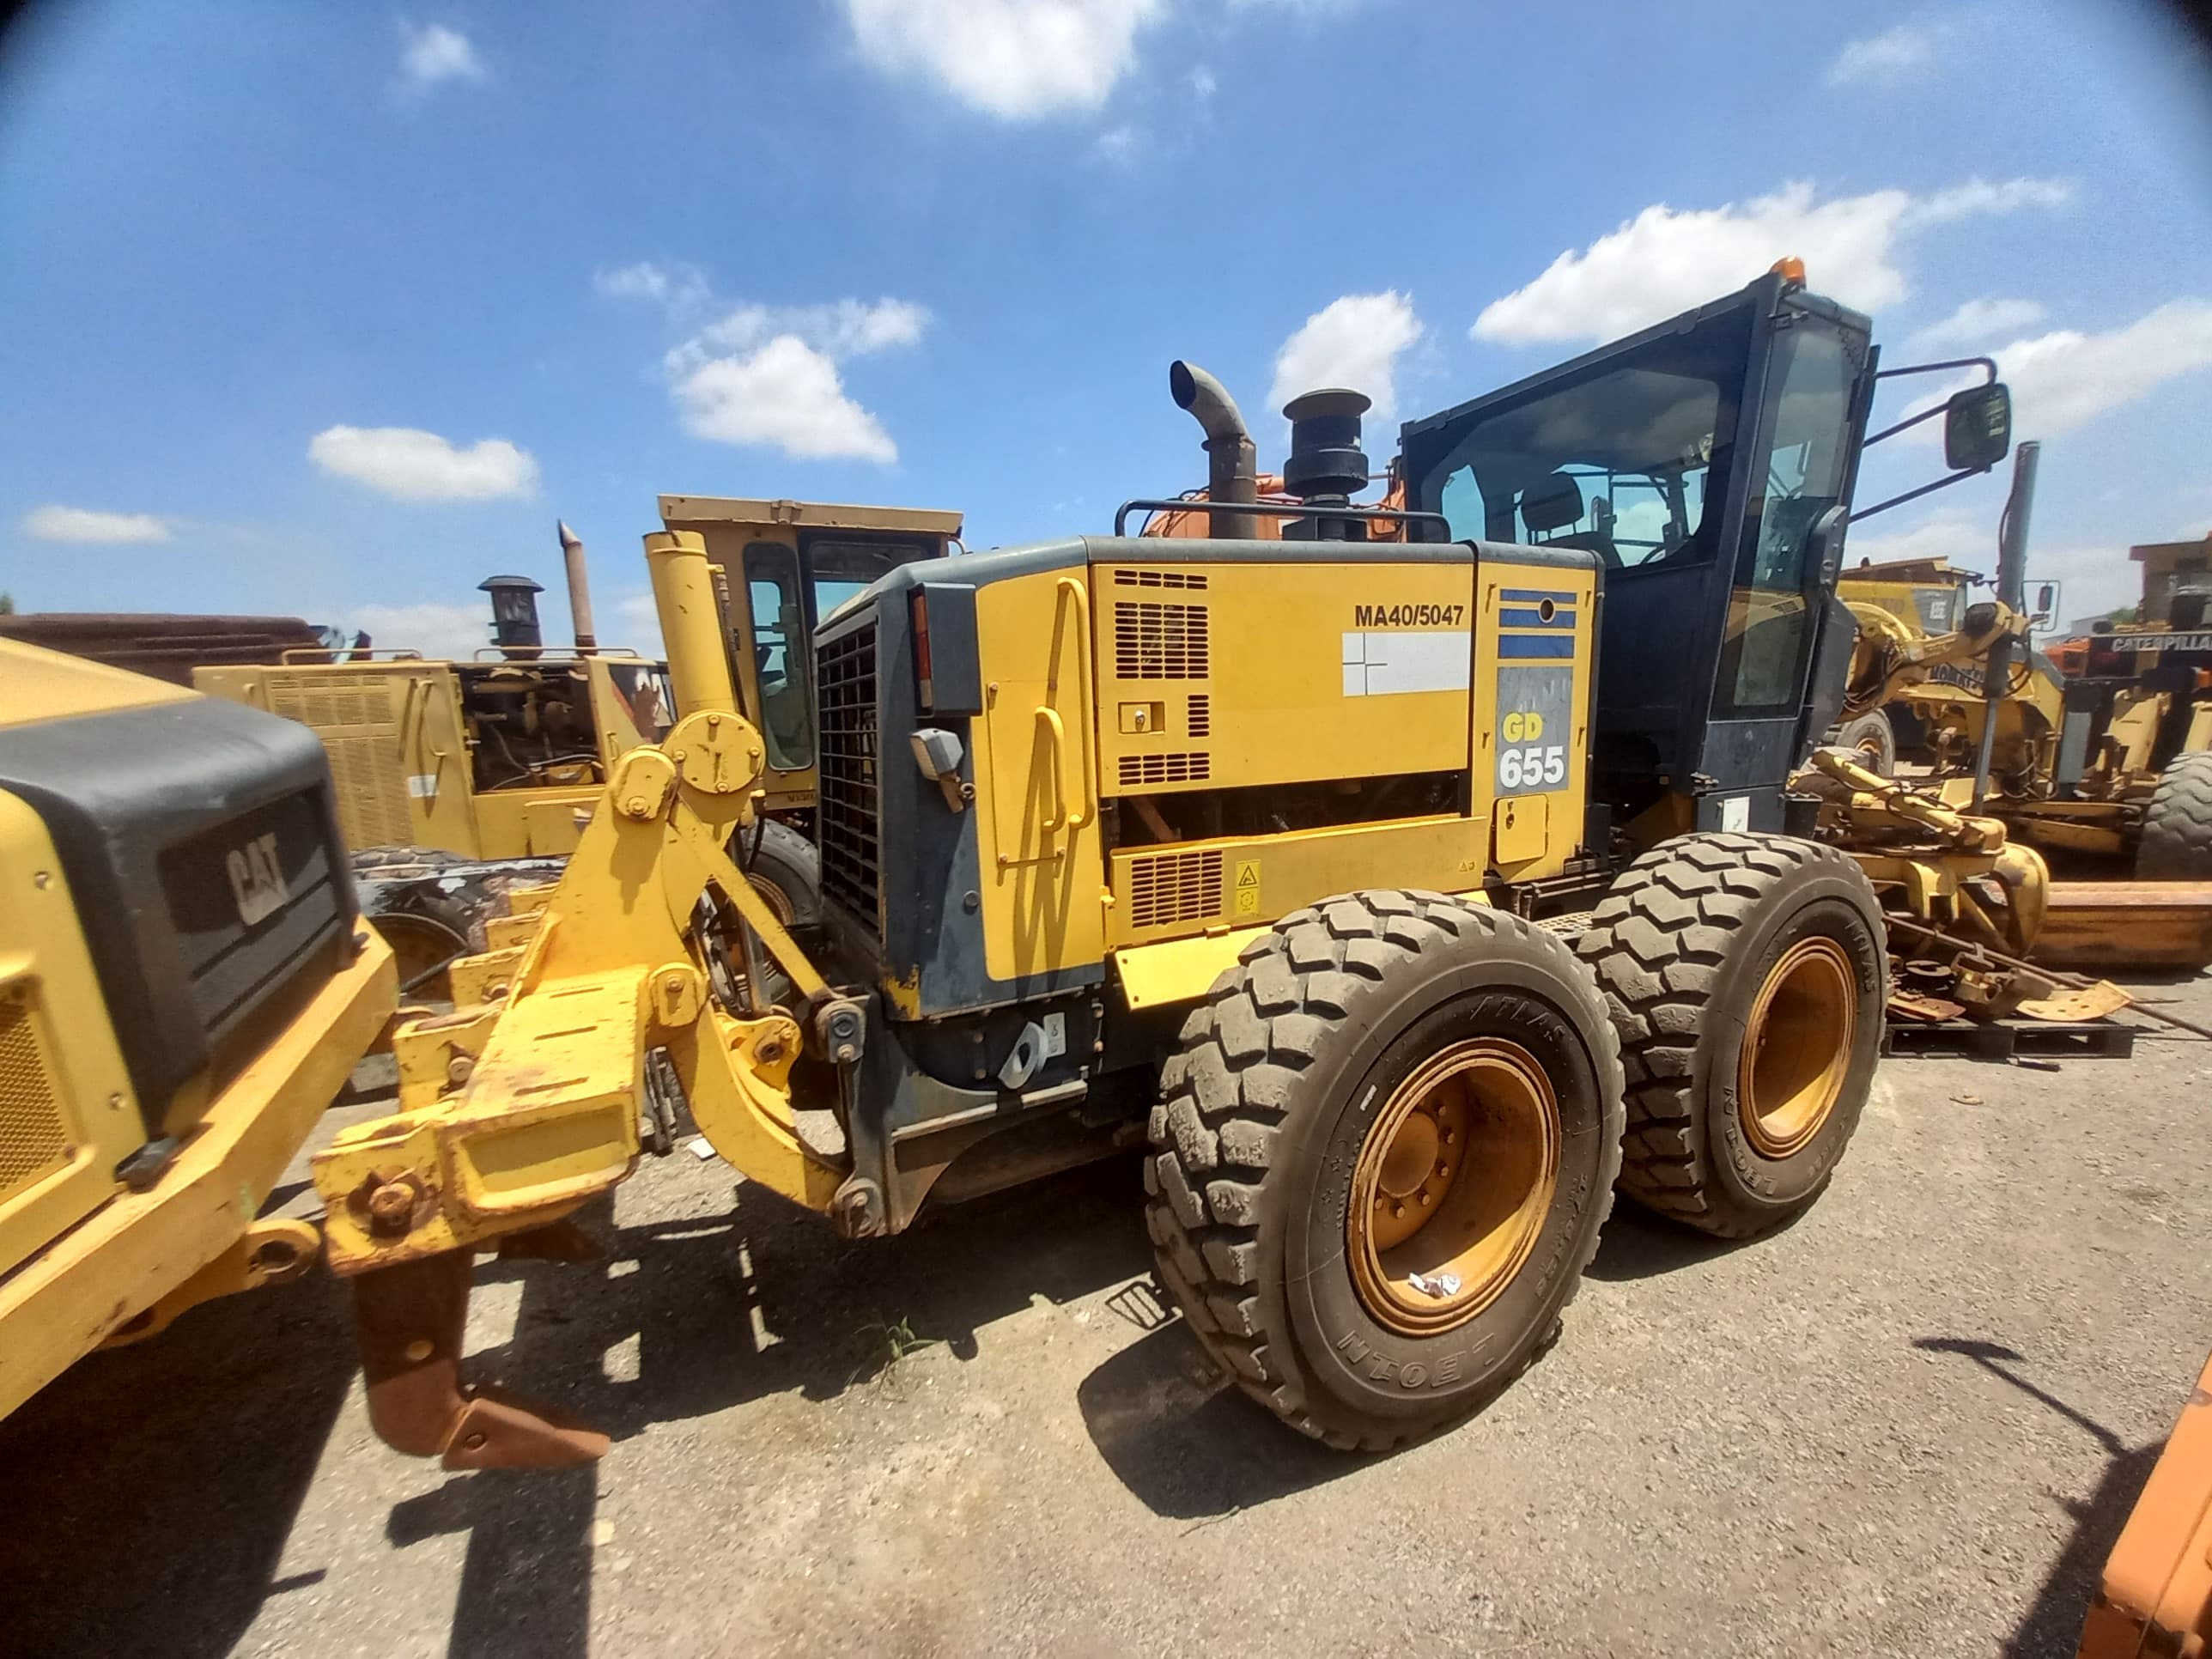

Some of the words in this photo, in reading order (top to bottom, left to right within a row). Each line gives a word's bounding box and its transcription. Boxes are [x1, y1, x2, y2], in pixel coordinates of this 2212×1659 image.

[1355, 604, 1464, 627] MA40/5047
[1503, 712, 1543, 743] GD
[1499, 745, 1563, 788] 655
[227, 831, 290, 926] CAT
